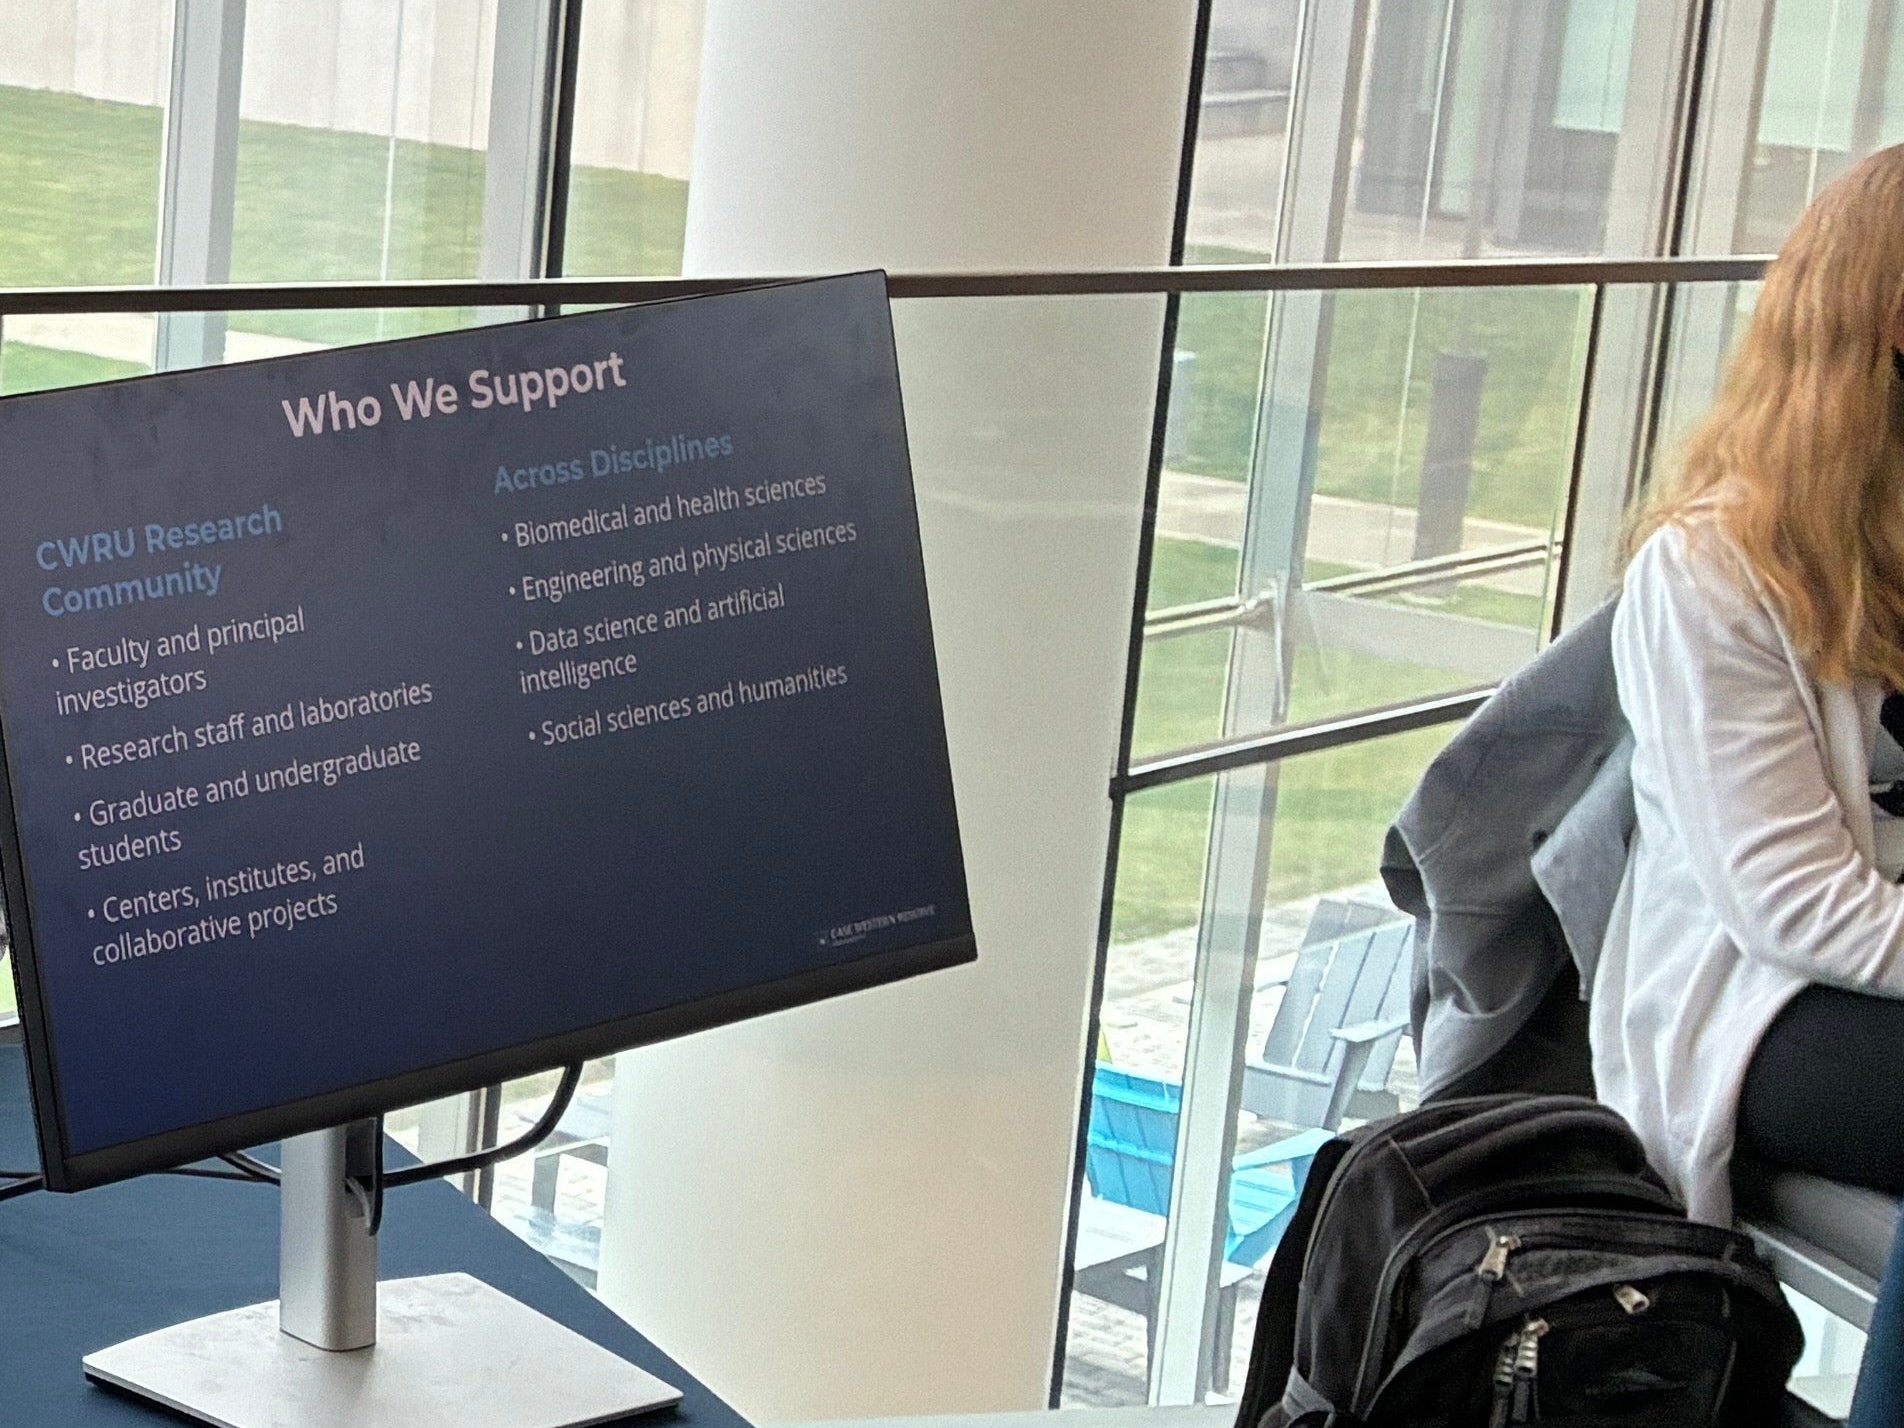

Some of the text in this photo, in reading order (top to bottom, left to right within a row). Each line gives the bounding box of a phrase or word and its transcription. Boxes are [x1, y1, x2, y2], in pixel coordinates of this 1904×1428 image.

[281, 352, 627, 438] Who We Support
[492, 430, 733, 494] Across Disciplines
[36, 504, 282, 571] CWRU Research
[515, 473, 827, 548] Biomedical and health sciences
[42, 561, 222, 617] Community
[522, 520, 857, 602] Engineering and physical sciences
[67, 606, 305, 674] Faculty and principal
[529, 582, 785, 655] Data science and artificial
[57, 666, 207, 715] investigators
[520, 650, 638, 694] intelligence
[541, 661, 848, 746] Social sciences and humanities
[80, 680, 433, 770] Research staff and laboratories
[89, 738, 422, 827] Graduate and undergraduate
[78, 827, 182, 870] students
[102, 841, 365, 923] Centers, institutes, and
[92, 890, 338, 966] collaborative projects
